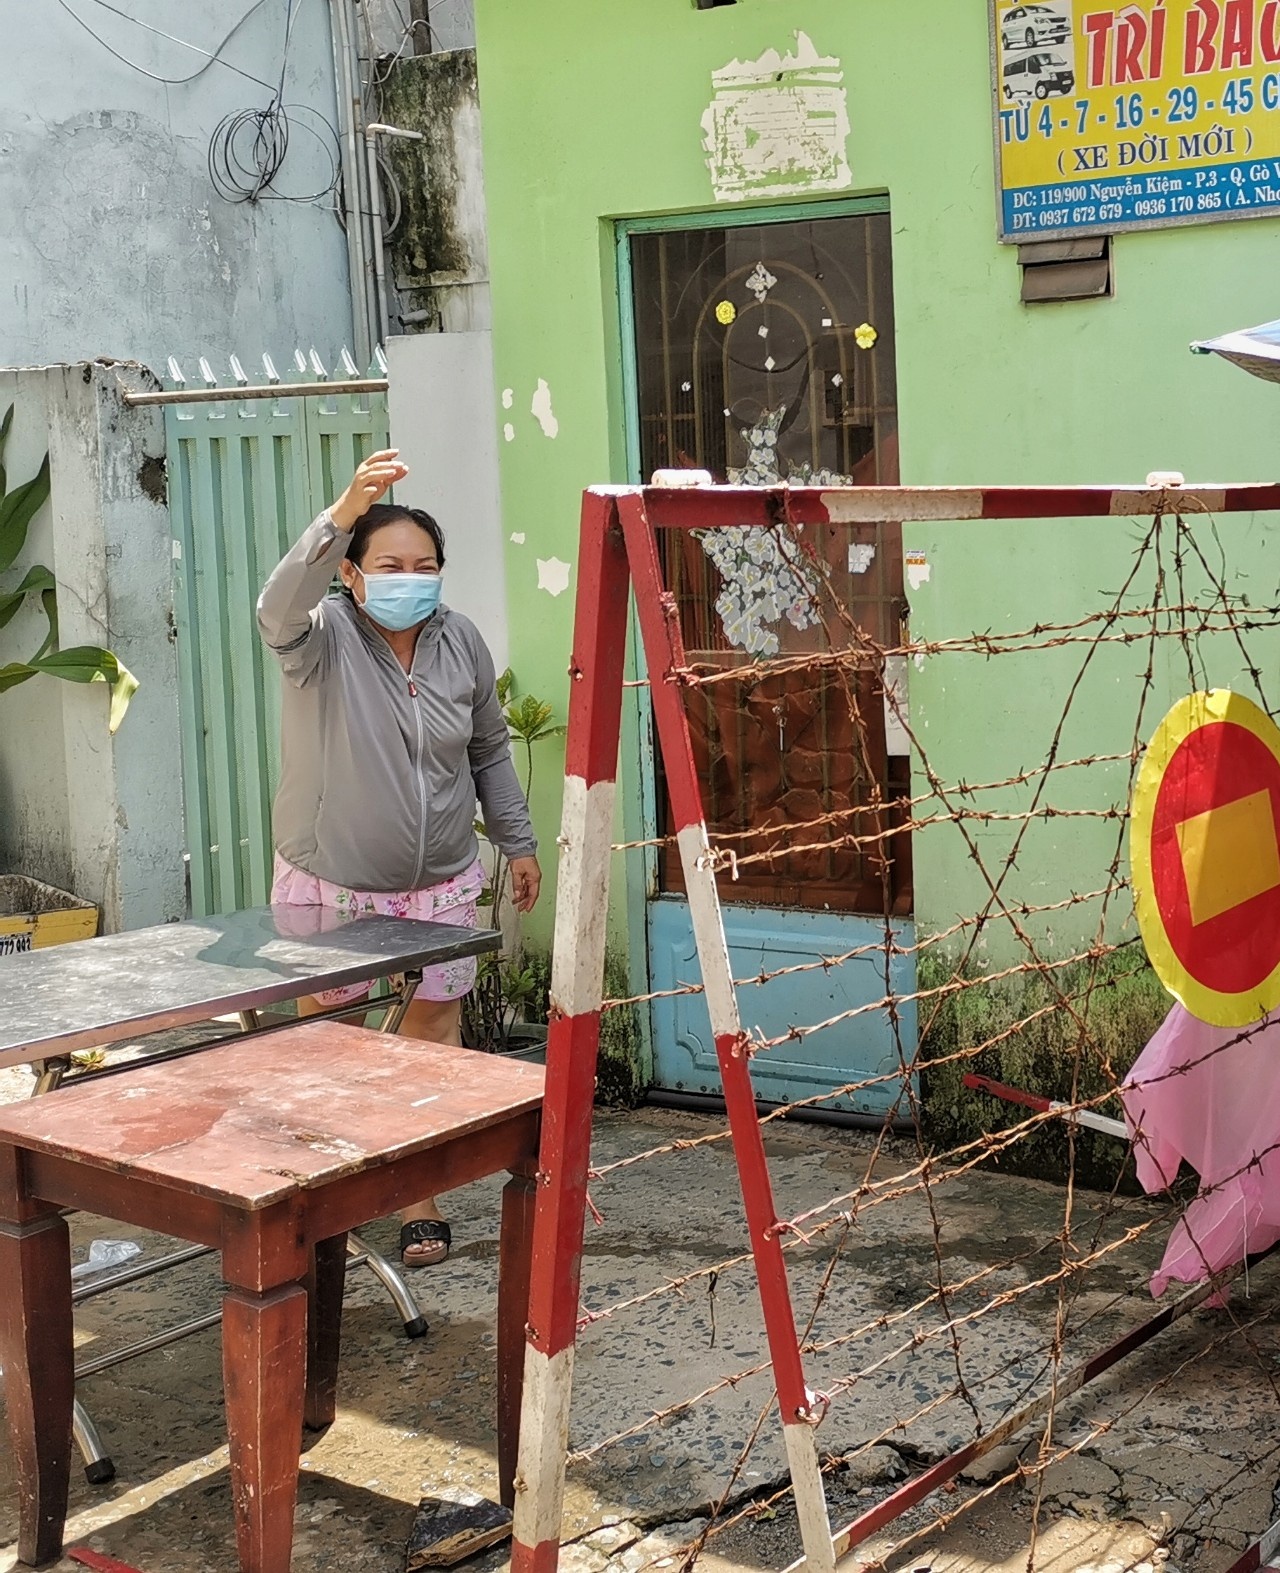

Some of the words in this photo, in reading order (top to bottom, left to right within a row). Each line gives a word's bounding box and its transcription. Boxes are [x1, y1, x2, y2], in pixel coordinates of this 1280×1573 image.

[1000, 101, 1030, 143] TỪ
[1038, 104, 1053, 139] 4
[1075, 100, 1090, 135] 7
[1116, 94, 1143, 130] 16
[1167, 86, 1197, 123] 29
[1222, 78, 1254, 116] 45
[1073, 144, 1109, 172] XE
[1118, 132, 1169, 167] ĐỜI
[1178, 122, 1236, 160] MỚI
[1012, 191, 1037, 210] ĐC:
[1039, 185, 1087, 207] 119/900
[1090, 176, 1143, 202] Nguyễn
[1145, 173, 1184, 196] Kiệm
[1194, 170, 1218, 189] P.3
[1230, 166, 1247, 186] Q.
[1249, 161, 1271, 183] Gò
[1012, 211, 1037, 230] ĐT:
[1039, 208, 1069, 227] 0937
[1072, 205, 1097, 224] 672
[1099, 202, 1123, 222] 679
[1134, 196, 1168, 217] 0936
[1170, 194, 1195, 214] 170
[1196, 191, 1222, 210] 865
[1235, 189, 1252, 207] A.
